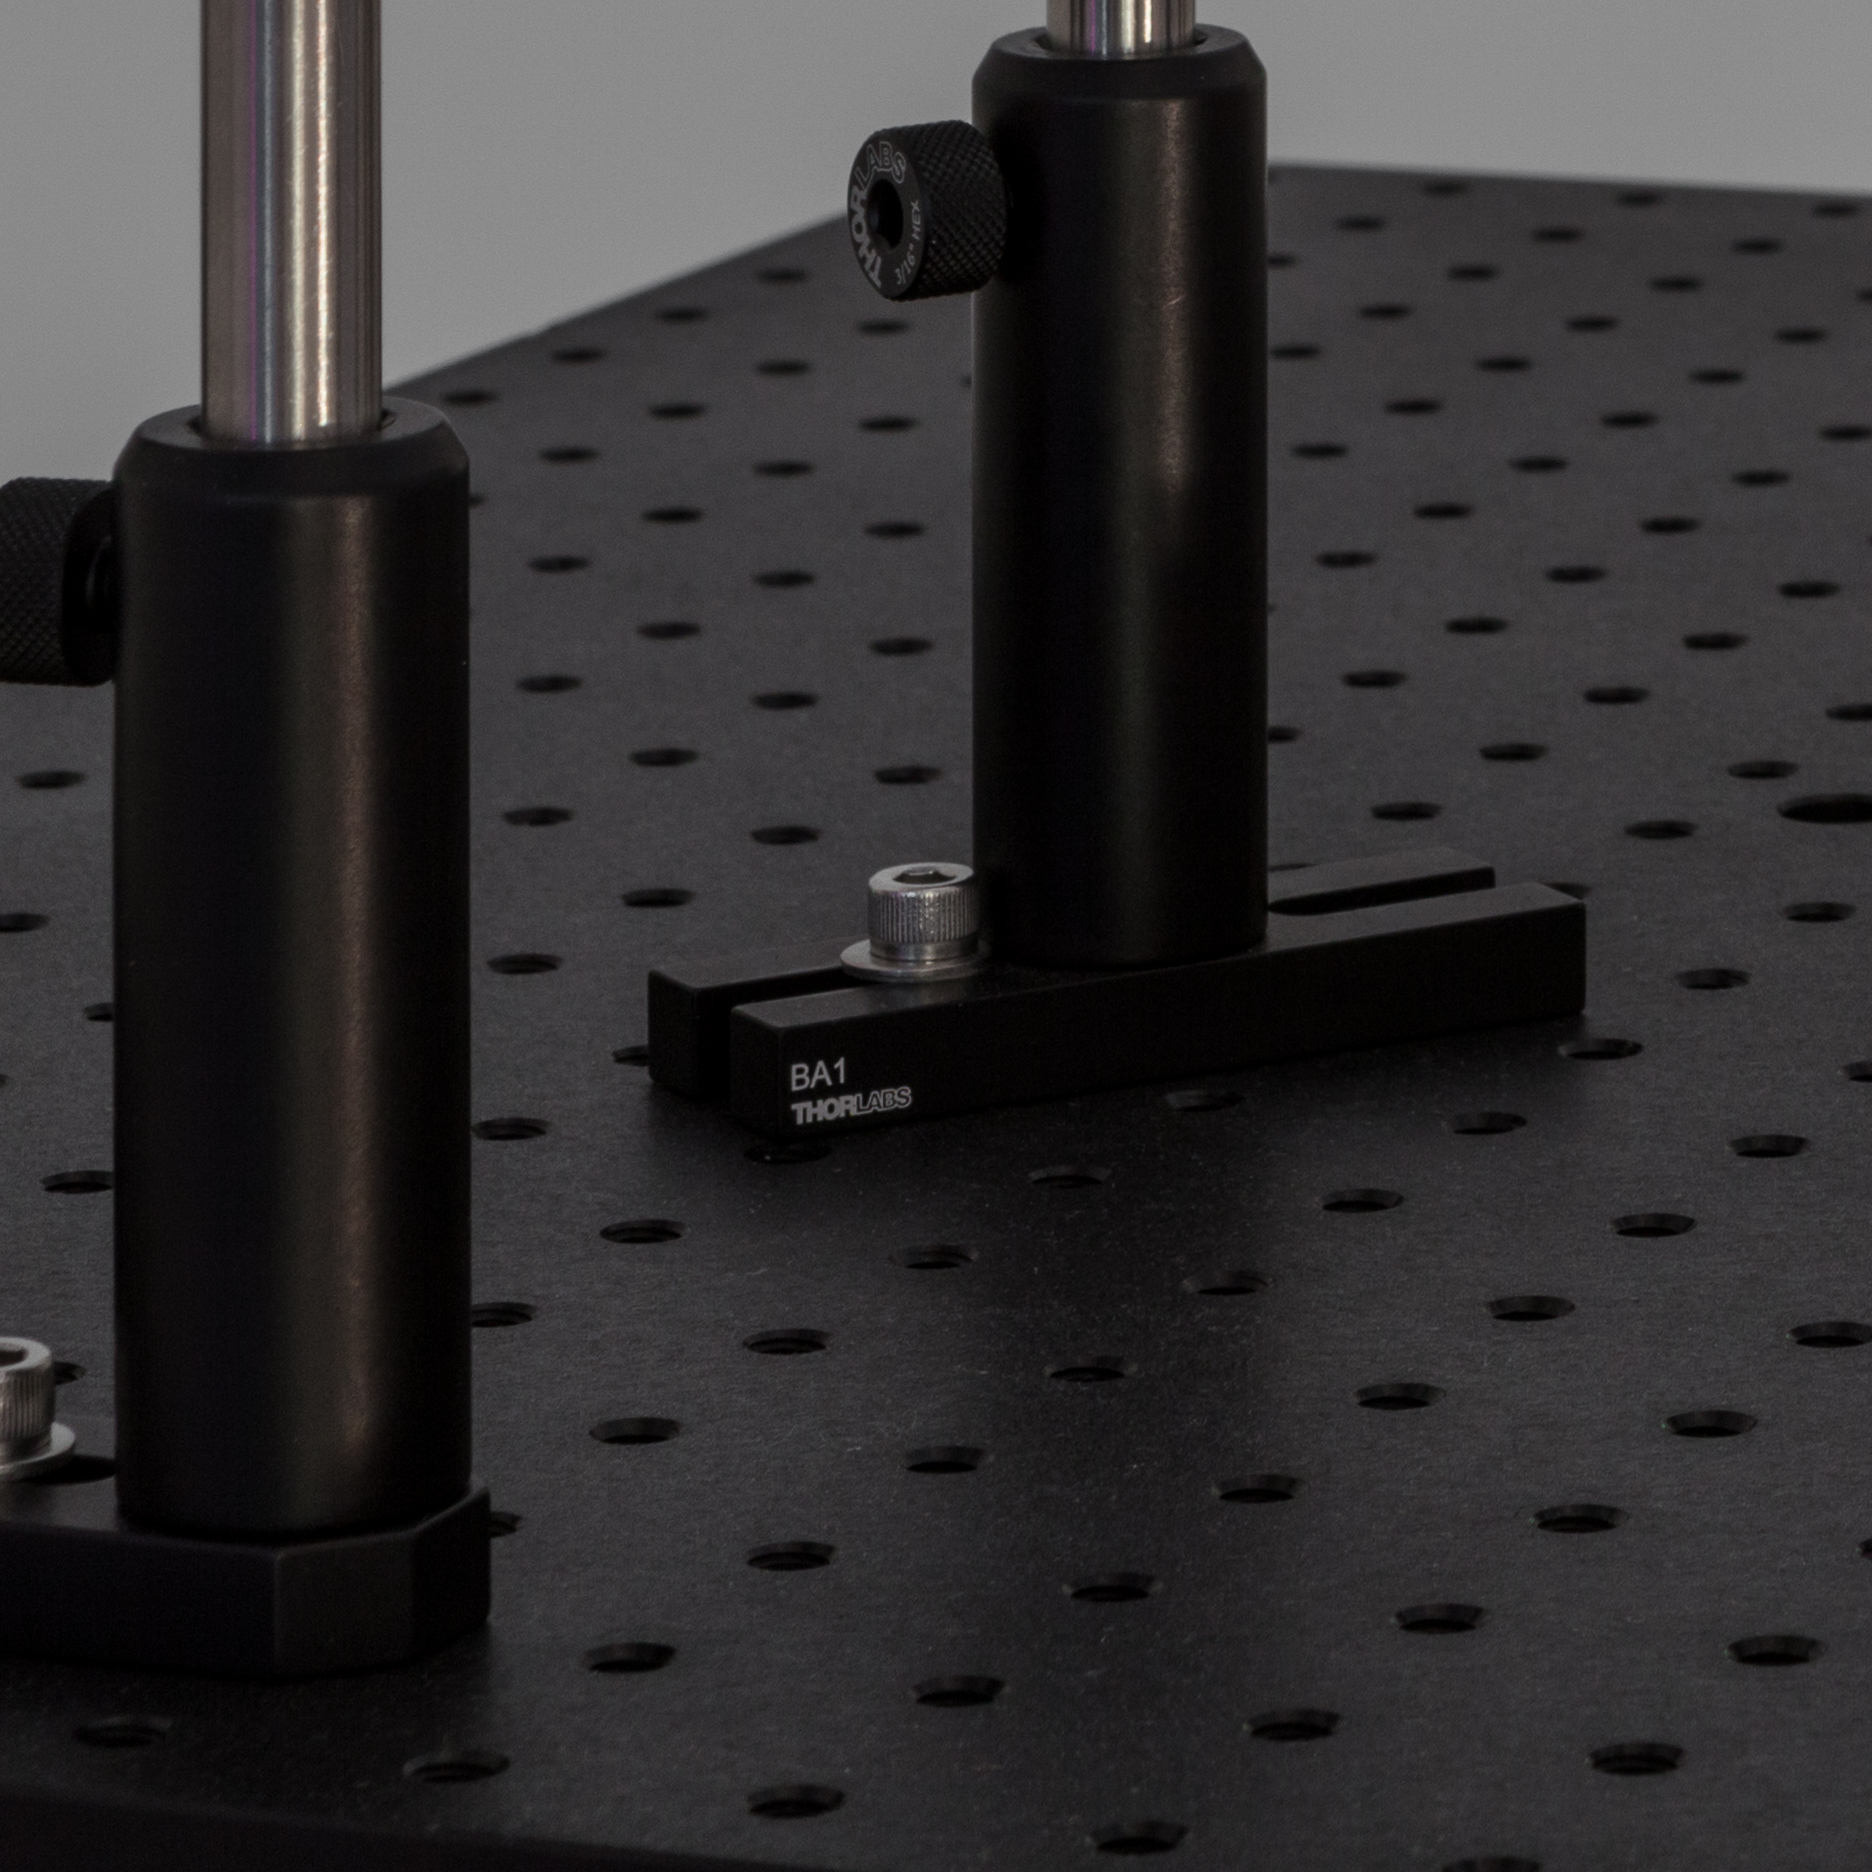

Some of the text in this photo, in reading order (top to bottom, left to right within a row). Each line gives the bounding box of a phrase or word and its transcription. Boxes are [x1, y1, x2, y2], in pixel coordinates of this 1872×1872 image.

[850, 141, 907, 289] THORLABS
[910, 199, 923, 241] HEX
[791, 1056, 846, 1093] BA1
[791, 1085, 913, 1126] THORLABS
